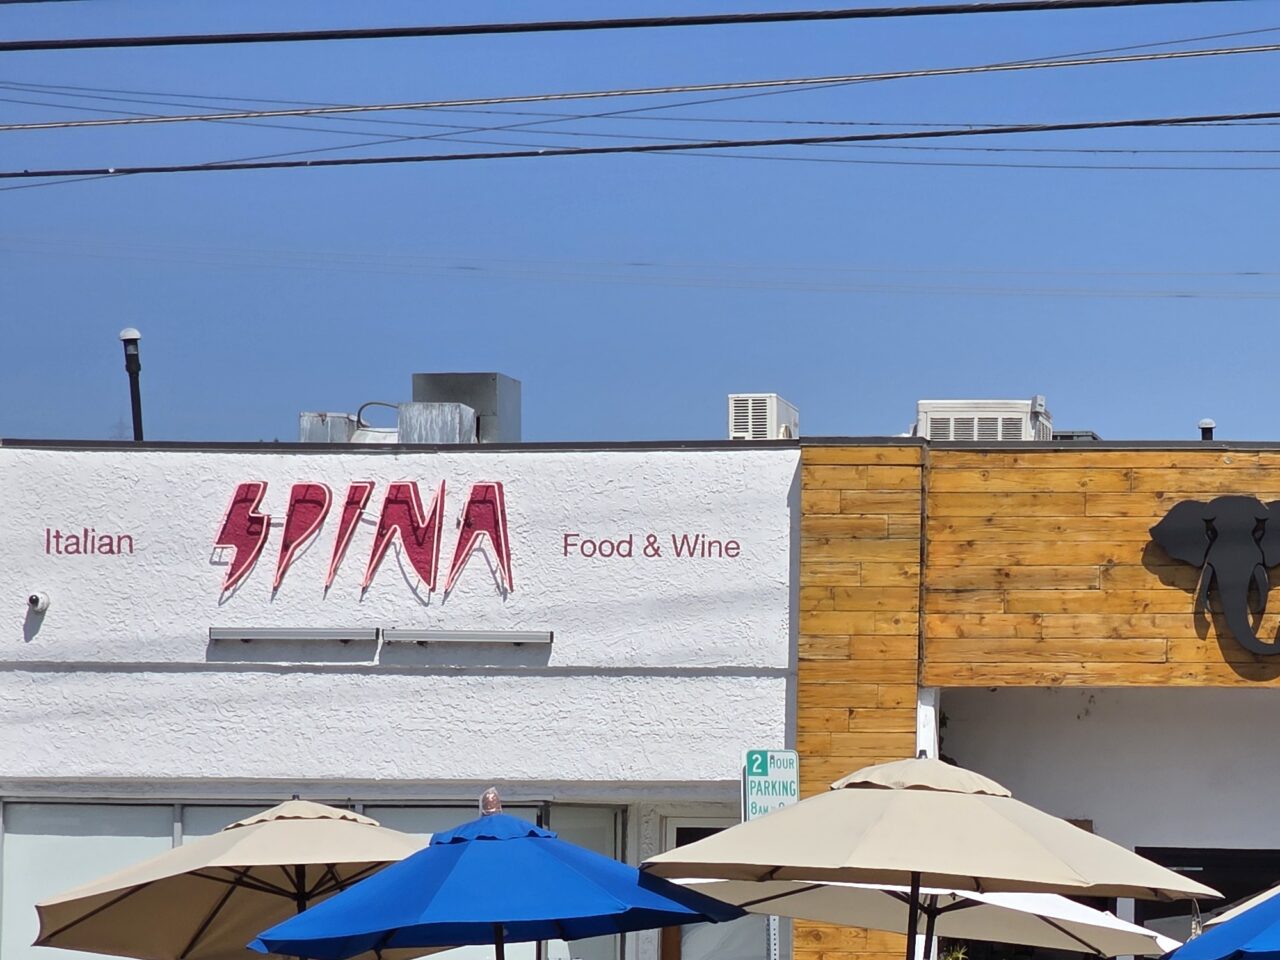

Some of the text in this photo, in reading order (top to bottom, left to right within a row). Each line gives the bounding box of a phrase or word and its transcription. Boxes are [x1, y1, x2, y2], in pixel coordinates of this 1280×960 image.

[45, 527, 133, 555] Italian
[213, 480, 514, 593] SPINA
[563, 534, 741, 558] Food & Wine
[752, 754, 795, 773] 2 HOUR
[750, 780, 796, 797] PARKING
